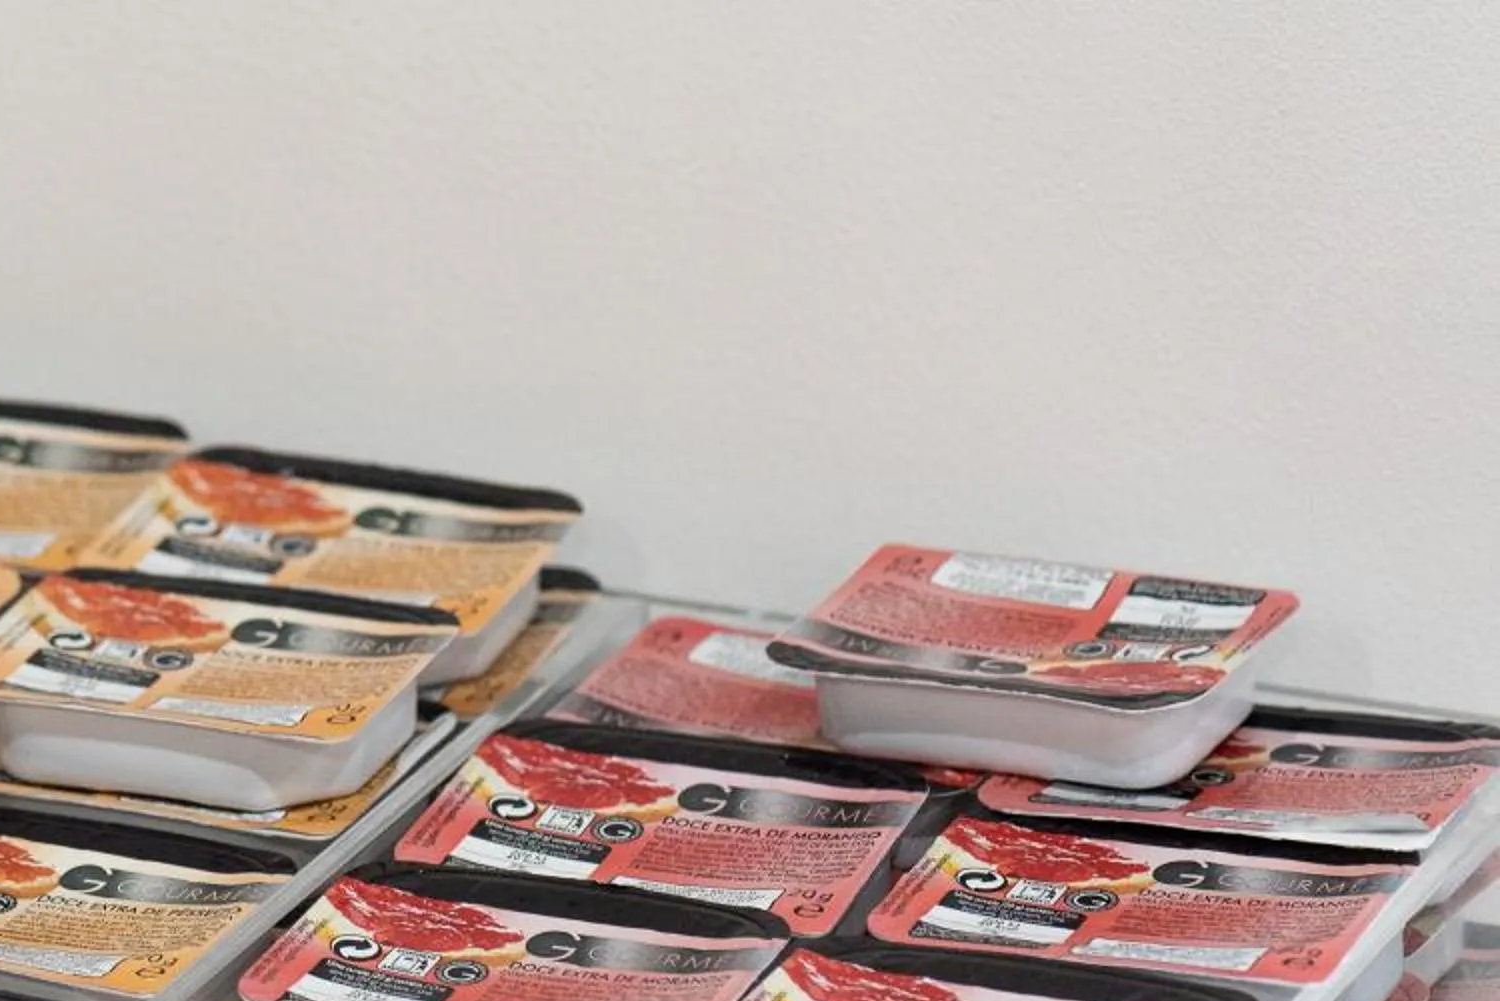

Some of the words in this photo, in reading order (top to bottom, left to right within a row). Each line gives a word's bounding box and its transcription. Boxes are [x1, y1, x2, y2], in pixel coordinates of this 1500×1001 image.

[678, 783, 731, 816] G
[662, 816, 710, 832] DOCE
[714, 823, 761, 838] EXTRA
[766, 828, 791, 840] DE
[793, 831, 882, 842] MORANGO
[526, 930, 581, 962] G
[509, 961, 558, 974] DOCE
[562, 969, 610, 982] EXTRA
[613, 974, 636, 984] DE
